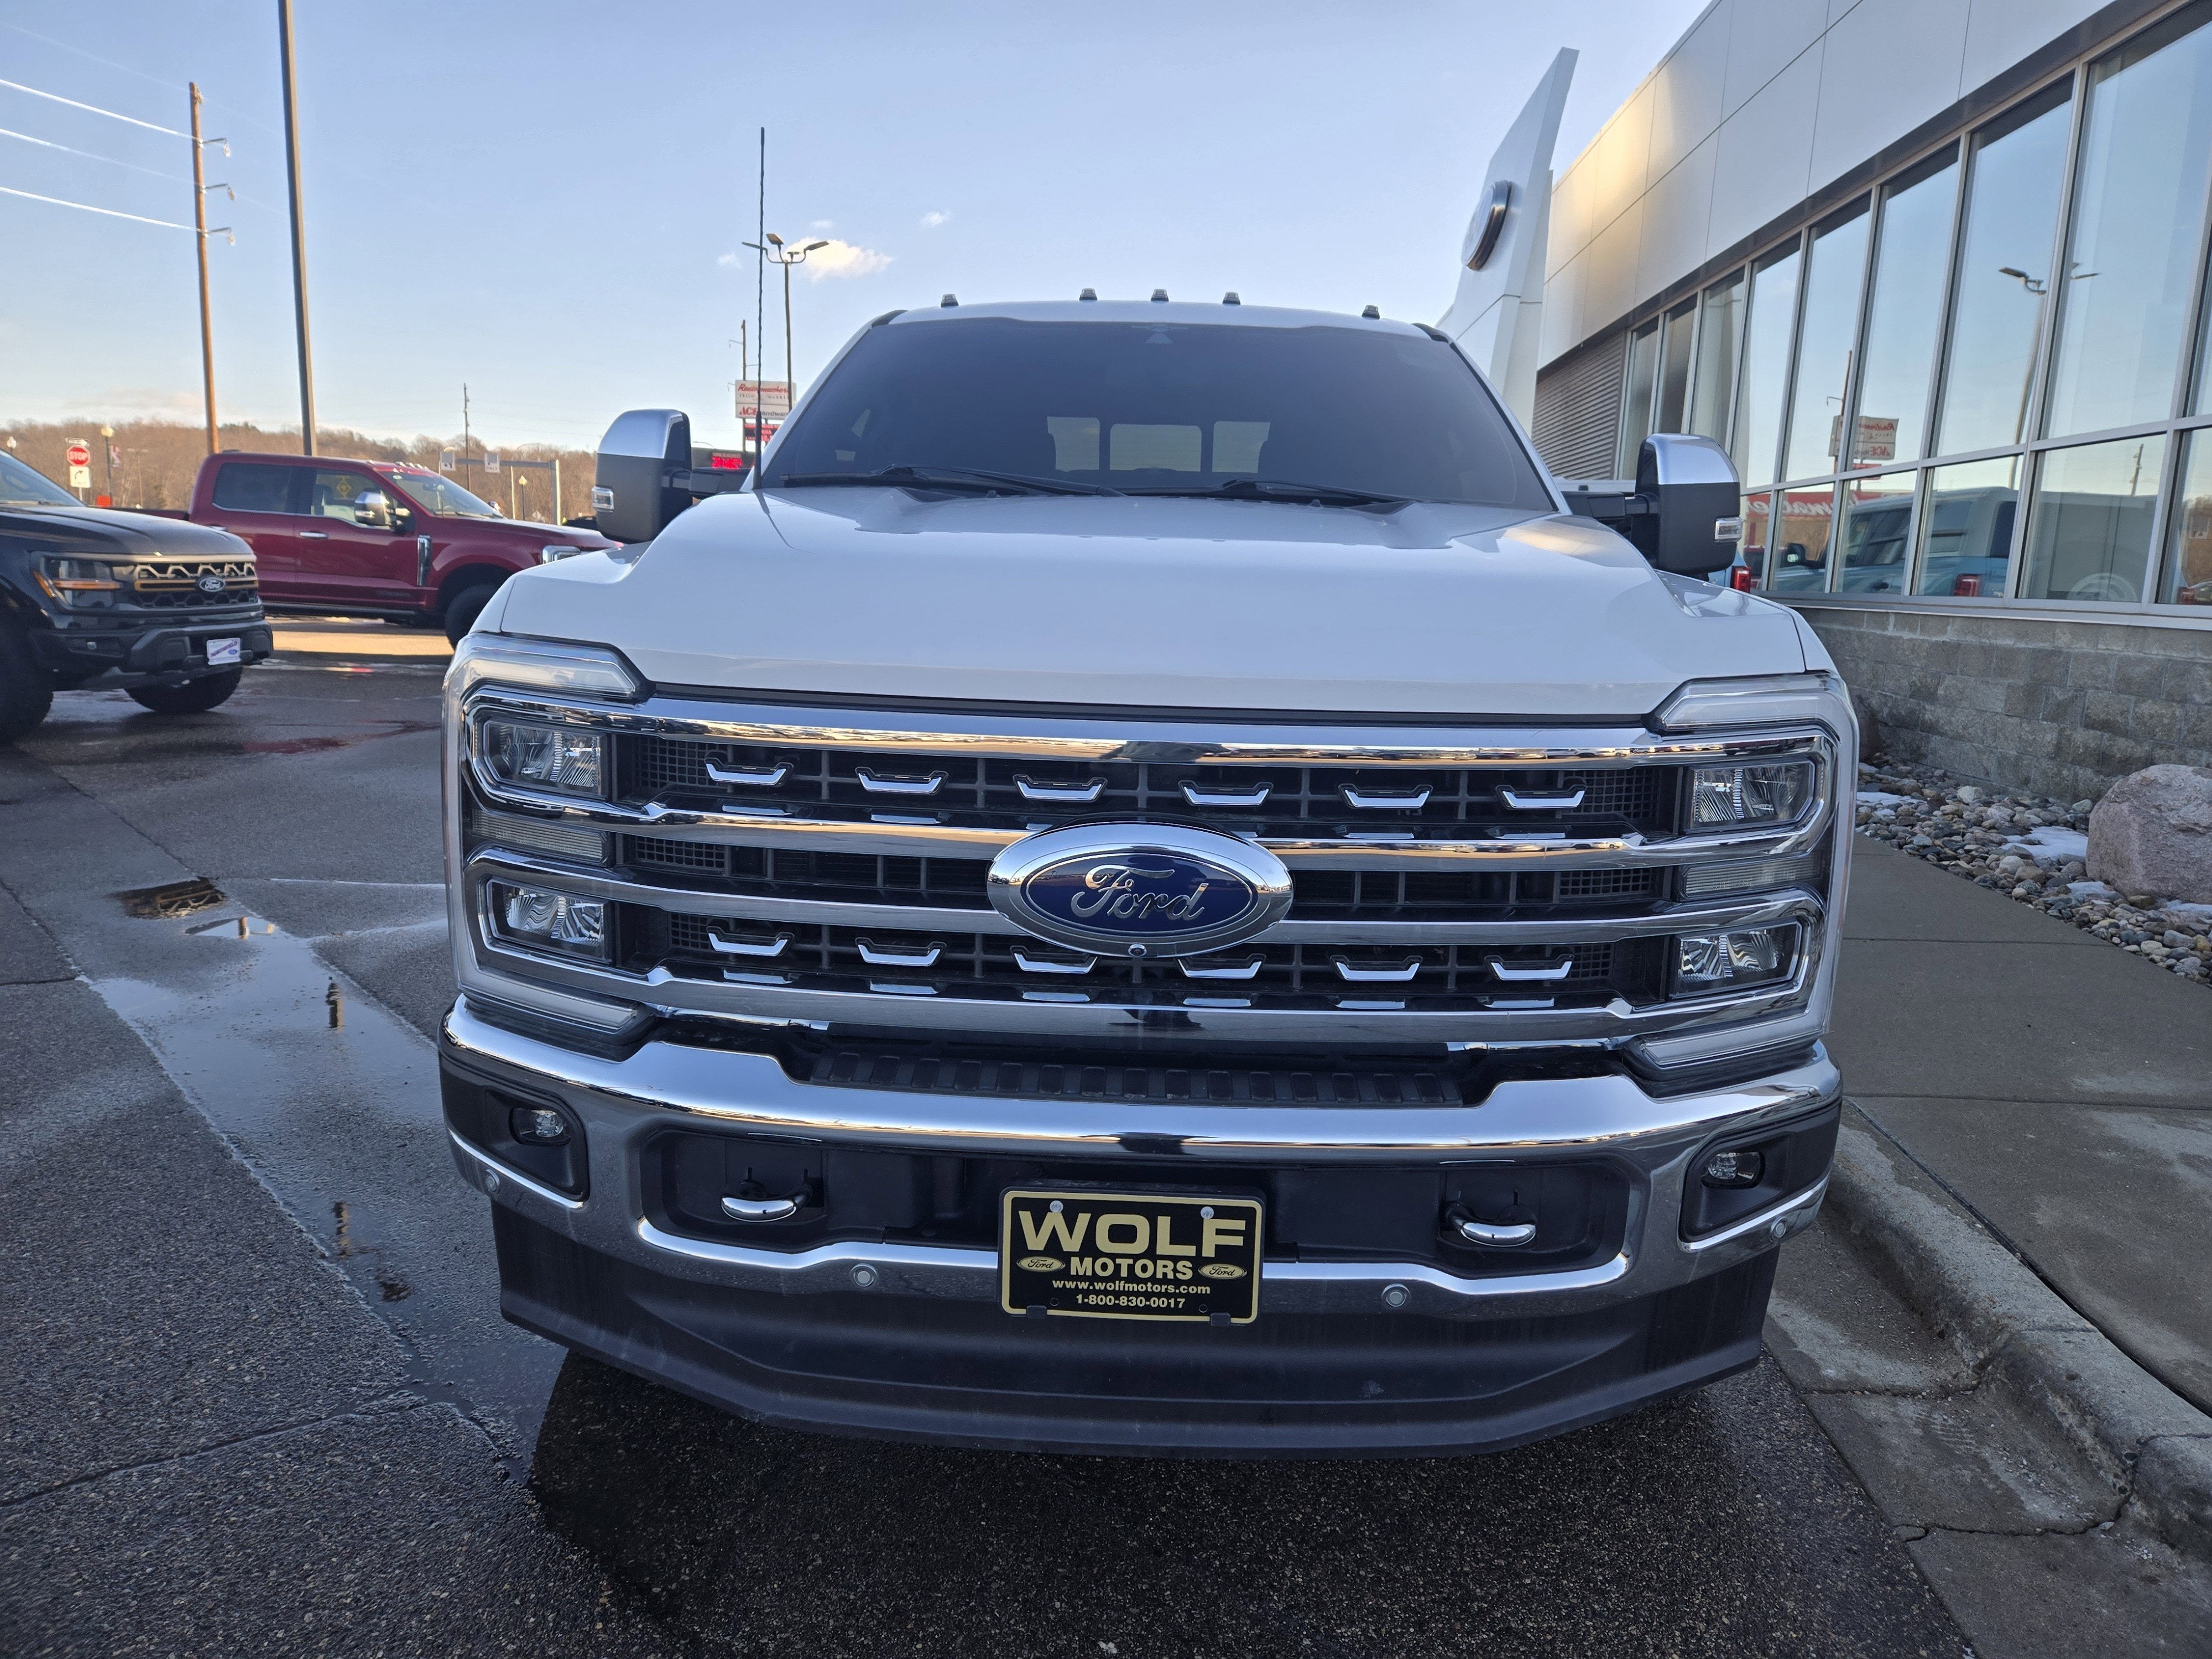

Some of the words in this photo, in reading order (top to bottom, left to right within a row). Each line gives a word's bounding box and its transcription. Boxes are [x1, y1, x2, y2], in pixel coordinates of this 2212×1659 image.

[69, 451, 88, 461] STOP
[204, 579, 221, 589] Ford
[1071, 864, 1209, 921] Ford
[1019, 1211, 1246, 1257] WOLF
[1071, 1257, 1193, 1280] MOTORS
[1053, 1279, 1211, 1294] www.wolfmotors.com
[1076, 1294, 1185, 1308] 1-800-830-0017
